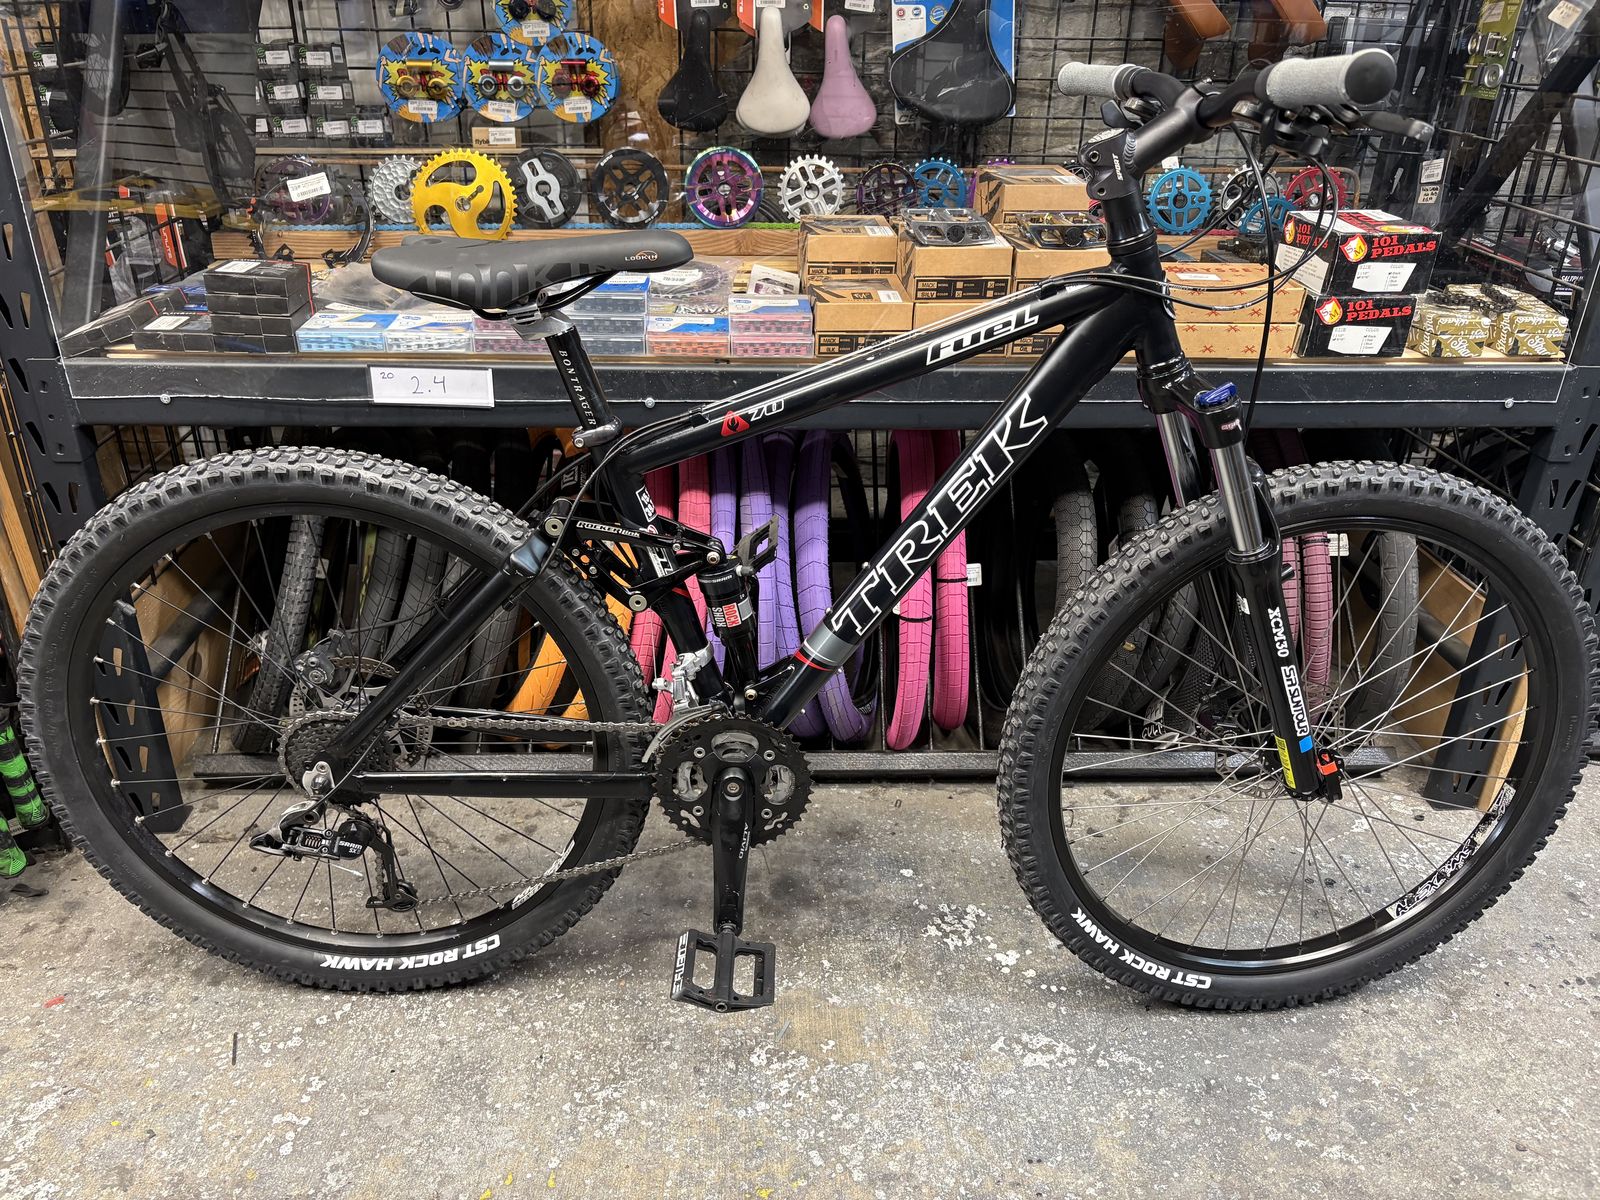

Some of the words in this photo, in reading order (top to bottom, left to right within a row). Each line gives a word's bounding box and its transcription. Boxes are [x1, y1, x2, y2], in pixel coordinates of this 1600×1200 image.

[1370, 240, 1437, 259] PEDALS
[1372, 235, 1398, 248] 101
[1345, 305, 1412, 322] PEDALS
[1346, 300, 1374, 312] 101
[379, 371, 395, 380] 20
[410, 375, 446, 394] 2.4
[558, 350, 597, 425] BONTRAGER
[747, 399, 785, 421] 70
[831, 392, 1048, 636] TREK
[723, 604, 740, 627] ROCK
[1267, 606, 1289, 658] XCM30
[1288, 687, 1310, 737] SUNTOUR
[338, 840, 363, 850] SRAM
[737, 822, 750, 859] ALIVIO
[1070, 906, 1120, 955] HAWK
[462, 934, 501, 960] CST
[320, 954, 395, 971] HAWK
[398, 947, 459, 970] ROCK
[1118, 948, 1172, 981] ROCK
[1170, 971, 1212, 989] CST
